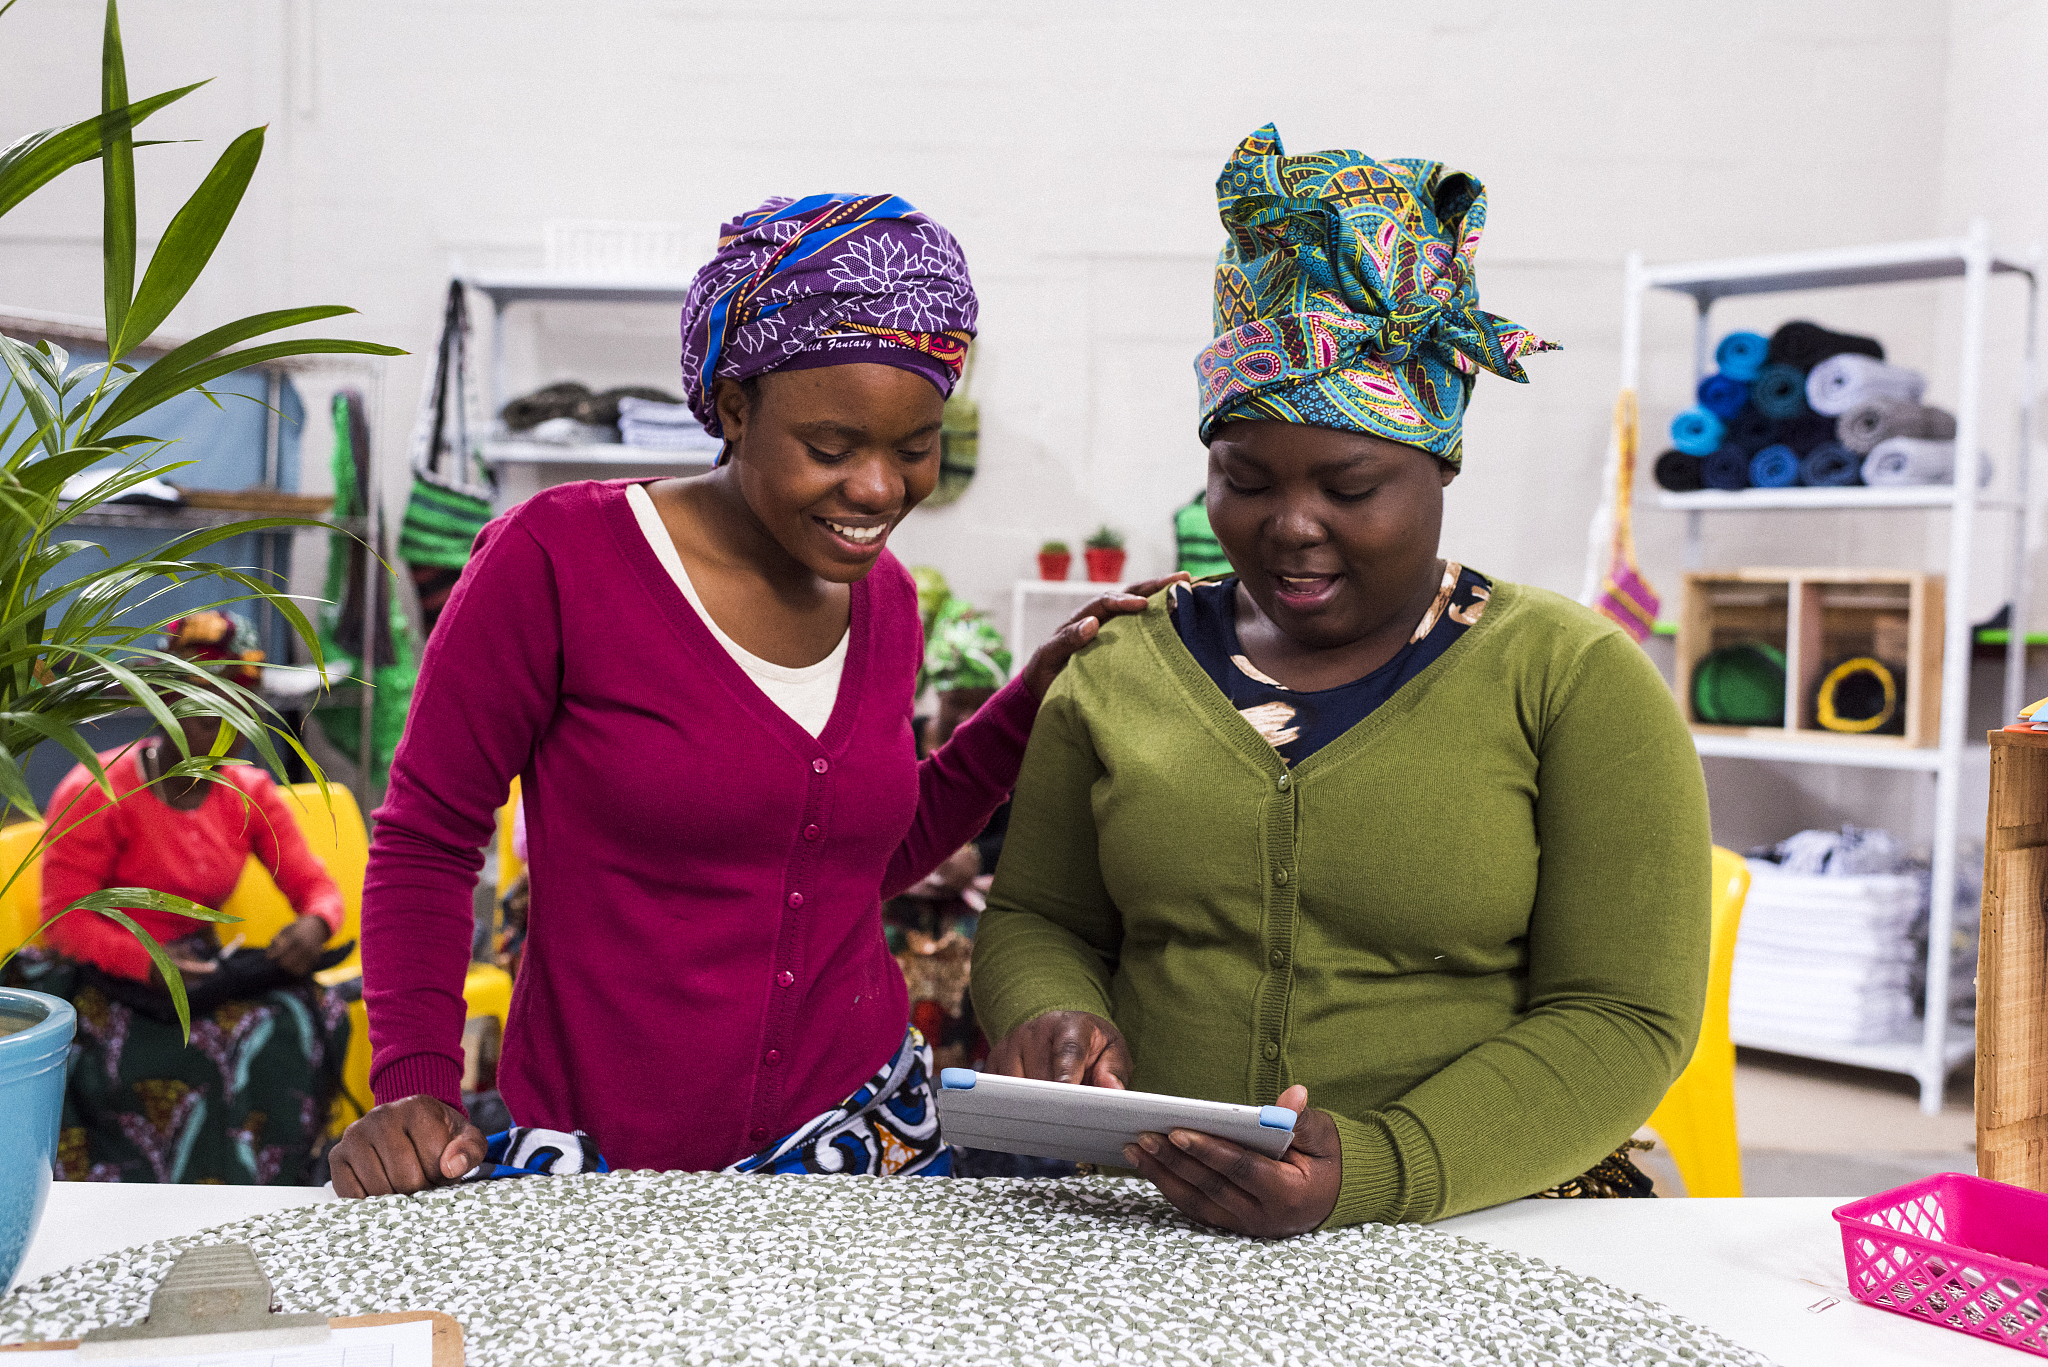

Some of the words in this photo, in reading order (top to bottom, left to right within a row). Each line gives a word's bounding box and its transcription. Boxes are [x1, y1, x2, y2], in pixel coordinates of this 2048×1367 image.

[801, 340, 822, 352] atik
[827, 338, 872, 351] Fantasy
[878, 338, 912, 350] NO.
